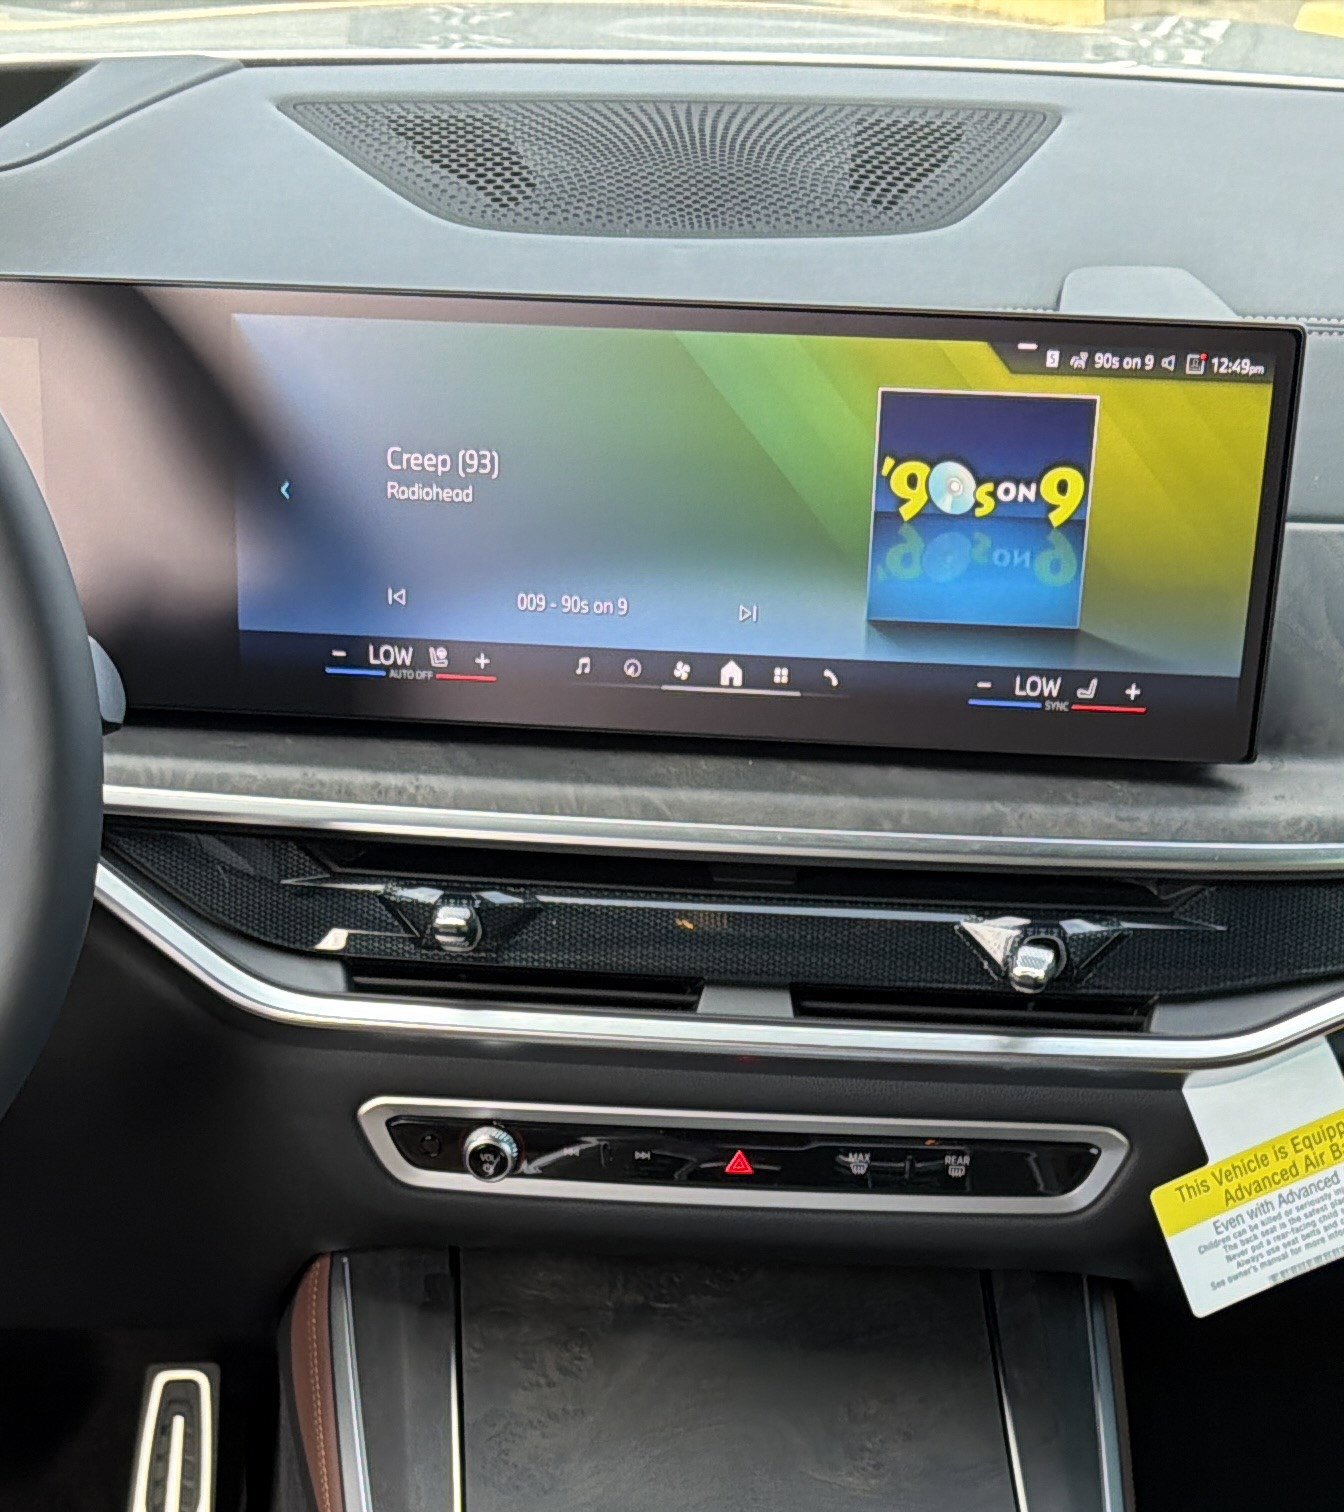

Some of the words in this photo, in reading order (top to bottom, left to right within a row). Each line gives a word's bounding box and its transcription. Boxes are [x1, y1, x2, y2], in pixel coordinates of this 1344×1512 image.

[1094, 352, 1119, 369] 90s
[1122, 355, 1141, 369] on
[1144, 354, 1154, 370] 9
[387, 446, 452, 476] Creep
[458, 449, 499, 479] (93)
[387, 481, 474, 503] Radiohead
[1040, 467, 1085, 528] 9
[517, 593, 546, 612] 009
[561, 595, 590, 614] 90s
[593, 600, 614, 614] on
[617, 597, 628, 616] 9
[368, 642, 414, 666] LOW
[389, 669, 414, 680] AUTO
[415, 670, 434, 681] OFF
[1014, 674, 1062, 697] LOW
[1044, 701, 1069, 712] SYNC
[848, 1152, 871, 1163] MAX
[944, 1154, 971, 1165] REAR
[1176, 1177, 1211, 1203] This
[1211, 1153, 1270, 1186] Vehicle
[1272, 1144, 1289, 1162] is
[1223, 1160, 1300, 1207] Advanced
[1304, 1150, 1326, 1173] Air
[1212, 1213, 1245, 1235] Even
[1246, 1199, 1275, 1220] with
[1277, 1170, 1340, 1208] Advanced
